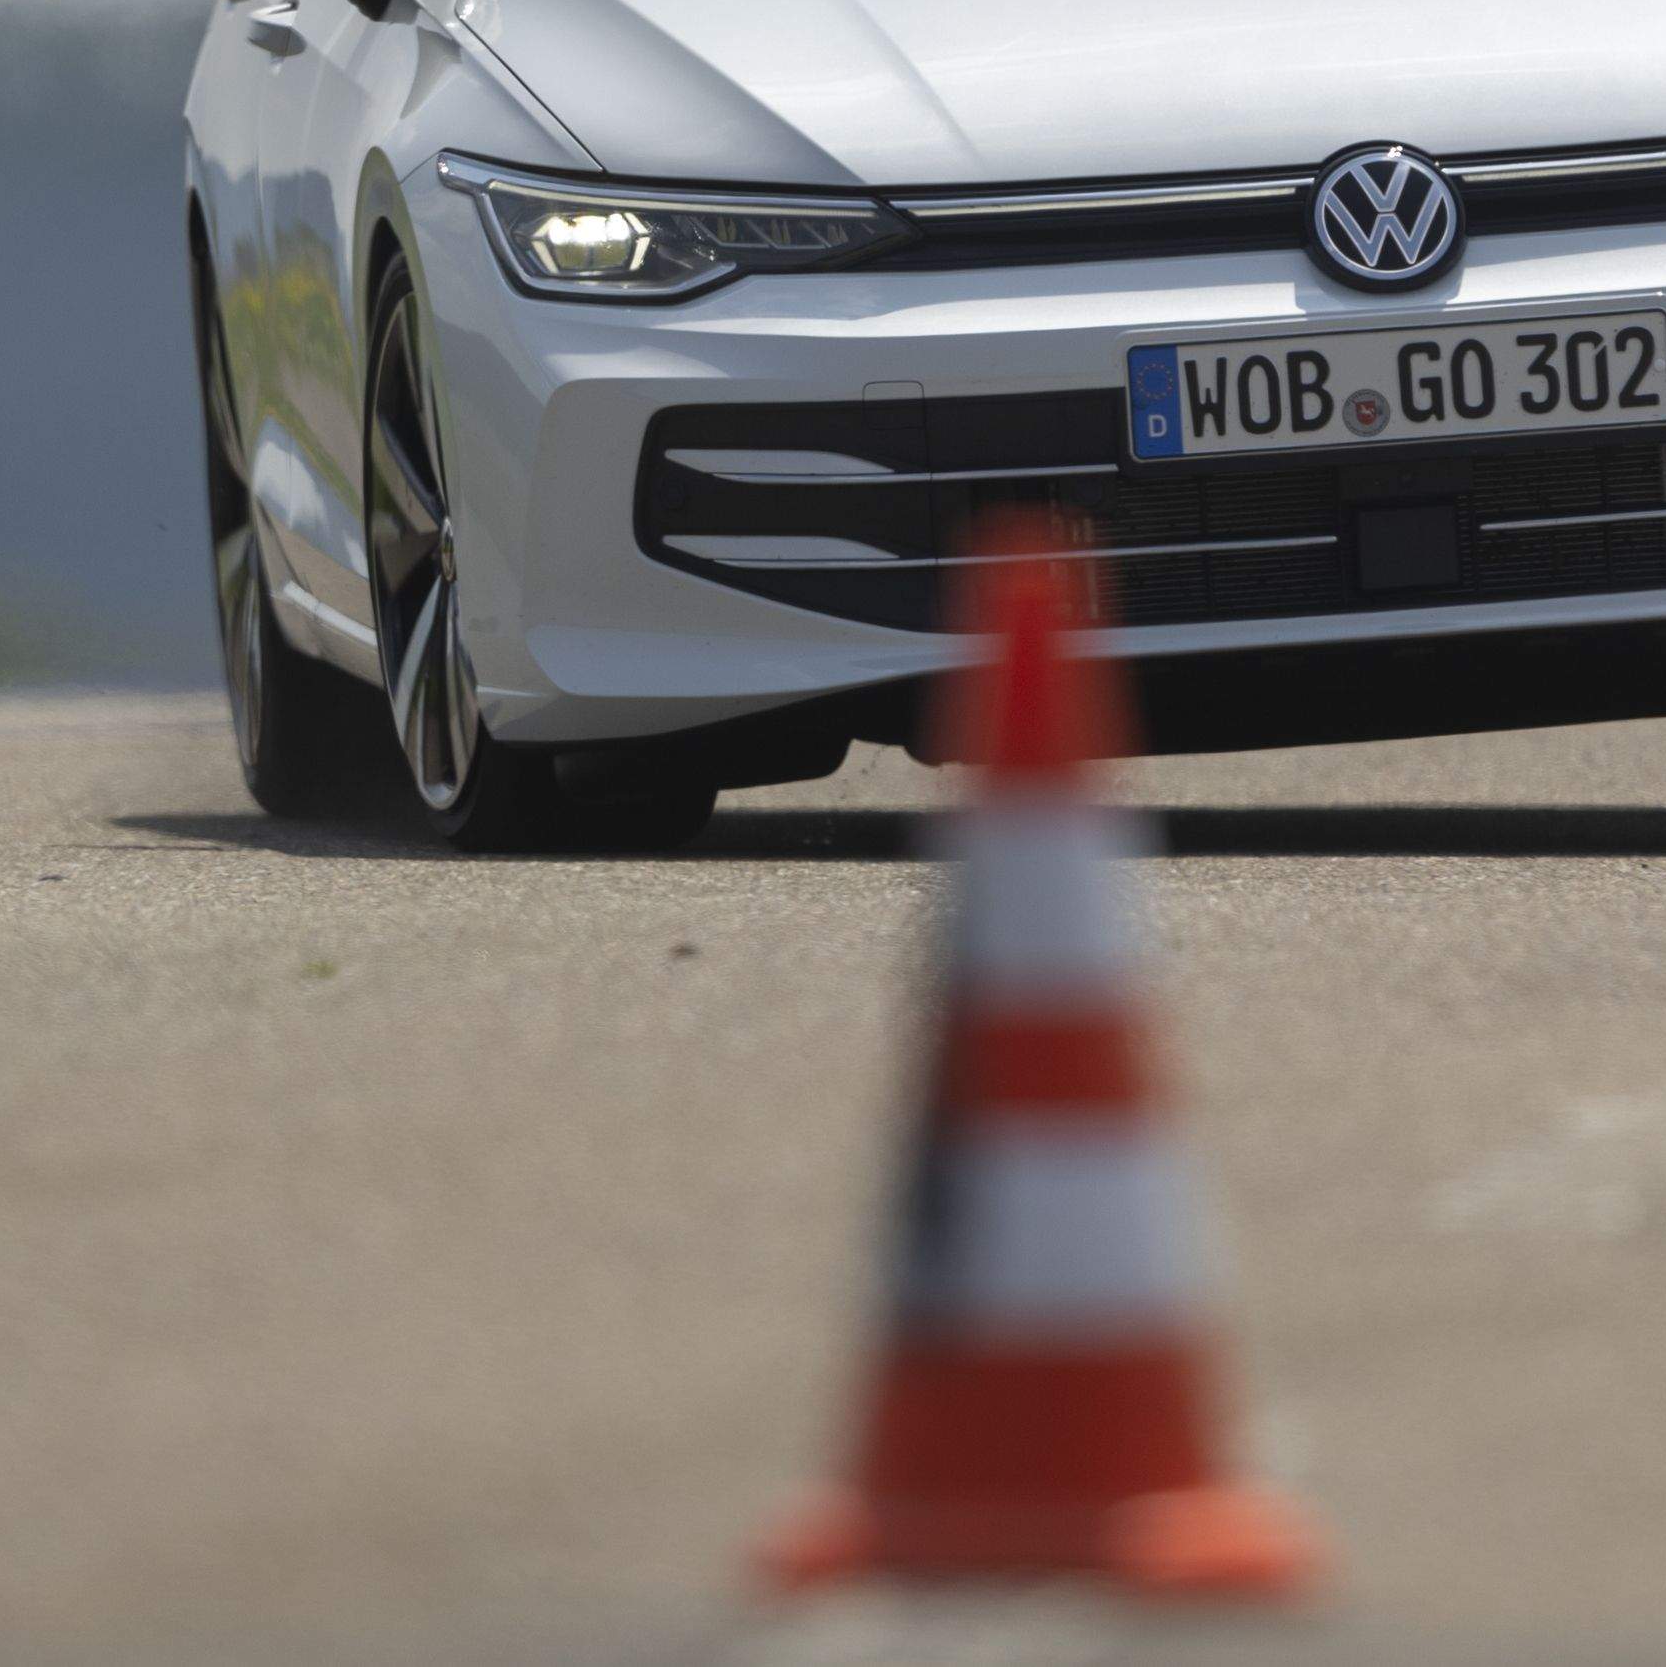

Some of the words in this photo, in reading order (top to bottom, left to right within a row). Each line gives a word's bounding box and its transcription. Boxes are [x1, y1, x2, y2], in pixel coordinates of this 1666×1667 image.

[1321, 156, 1449, 272] VW
[1148, 414, 1167, 437] D
[1183, 349, 1335, 439] WOB
[1396, 338, 1496, 424] GO
[1515, 326, 1660, 415] 302
